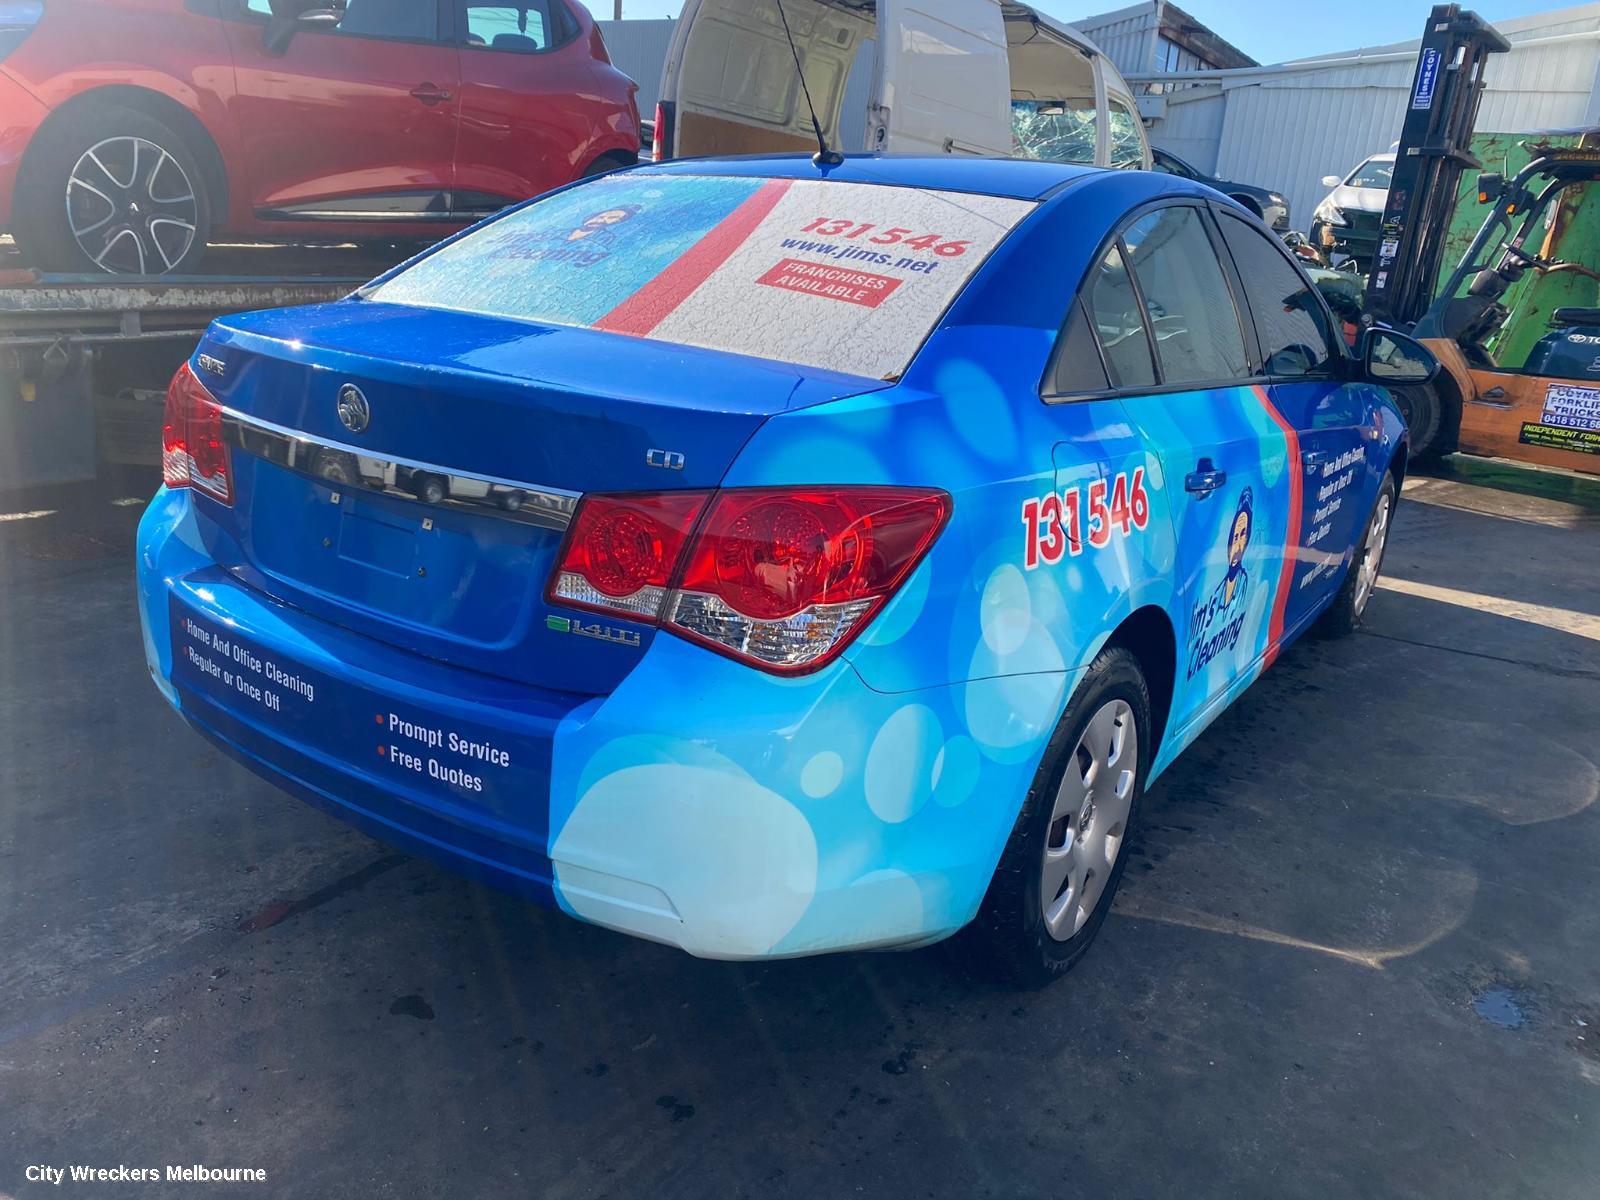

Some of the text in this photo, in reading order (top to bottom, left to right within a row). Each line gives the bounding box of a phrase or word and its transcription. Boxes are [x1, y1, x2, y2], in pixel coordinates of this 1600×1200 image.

[780, 237, 941, 275] www.jims.net
[800, 216, 973, 257] 131 546
[775, 275, 871, 301] AVAILABLE
[782, 262, 888, 290] FRANCHISES
[1523, 424, 1579, 439] INDEPENDENT
[1544, 414, 1568, 426] 0418
[1569, 417, 1588, 428] 512
[646, 448, 685, 470] CD
[1022, 466, 1149, 571] 131 546
[187, 618, 314, 702] Home And Office Cleaning
[1187, 611, 1246, 682] Cleaning
[188, 646, 280, 711] Regular or Once Off
[389, 713, 510, 767] Prompt Service
[390, 745, 482, 792] Free Quotes
